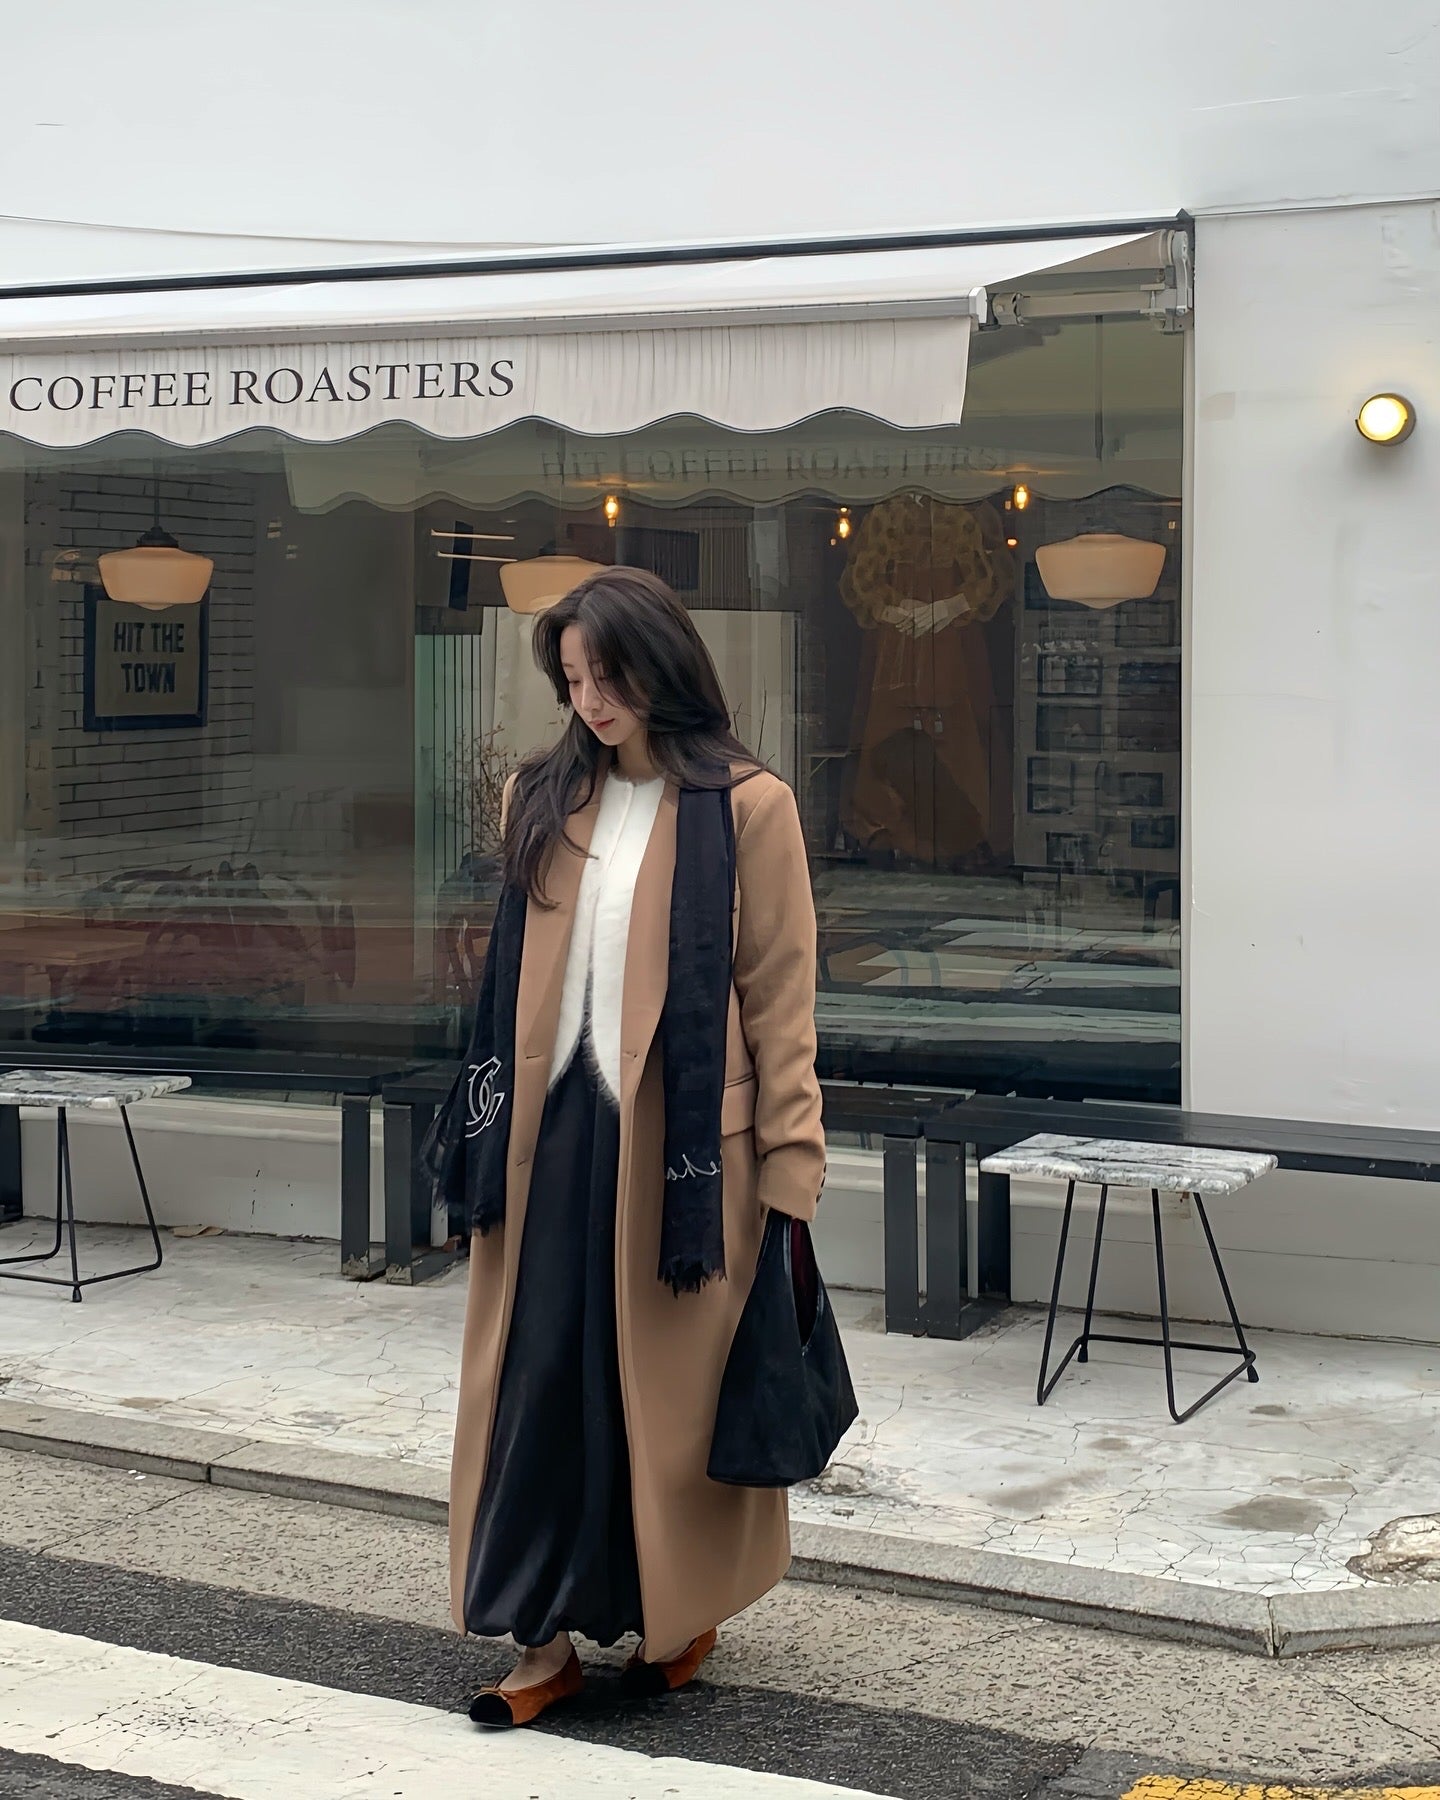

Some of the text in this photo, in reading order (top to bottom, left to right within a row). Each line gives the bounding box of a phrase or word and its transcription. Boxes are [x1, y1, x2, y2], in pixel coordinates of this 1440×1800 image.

[9, 359, 515, 411] COFFEE ROASTERS
[113, 622, 185, 653] HIT THE
[121, 662, 176, 693] TOWN
